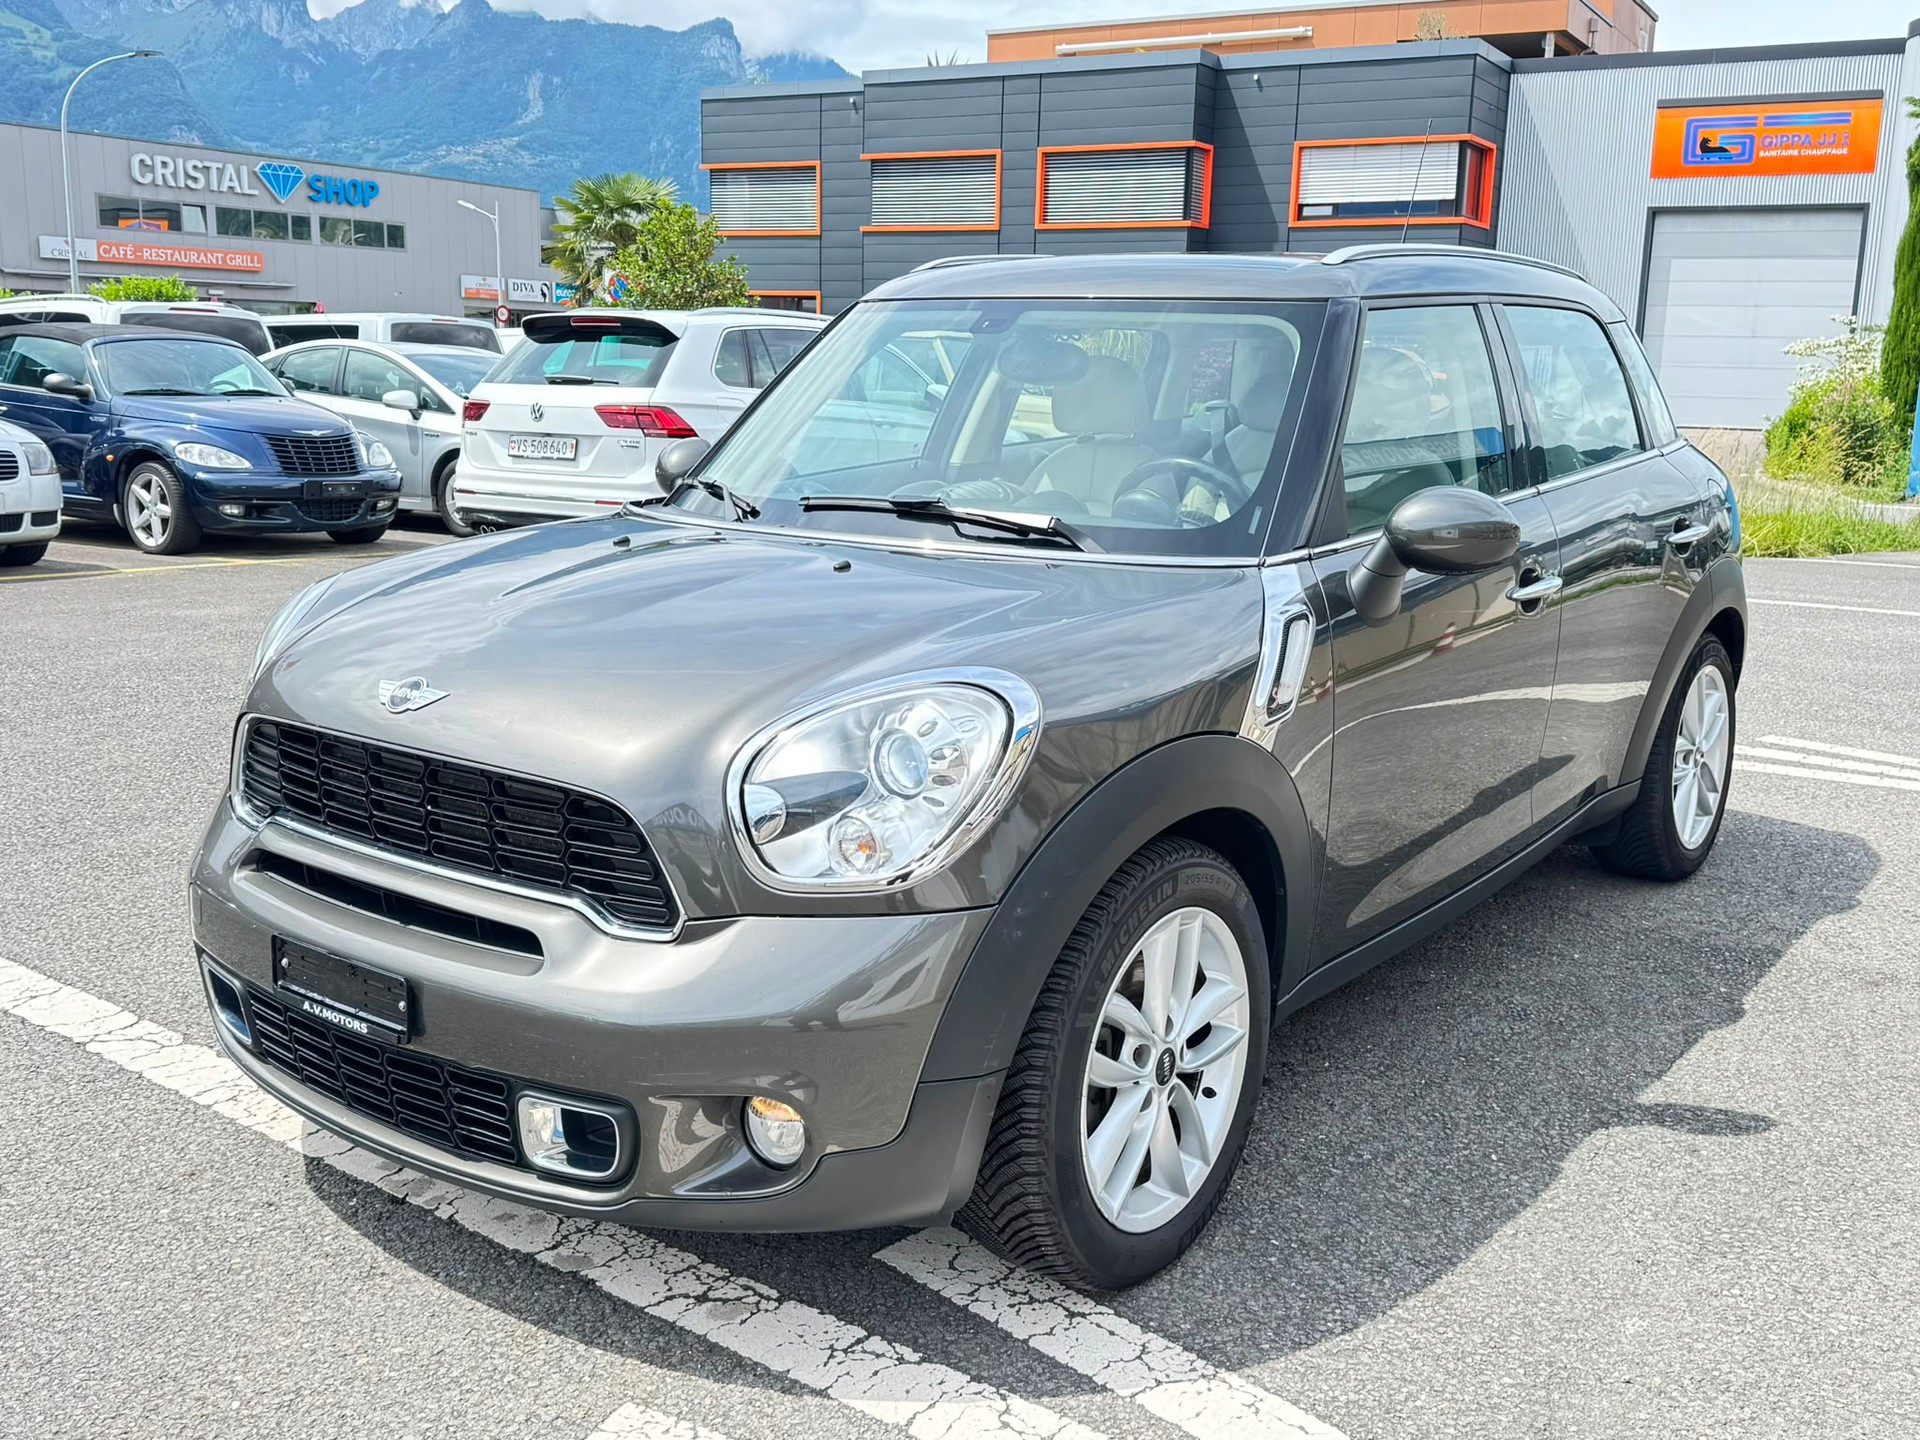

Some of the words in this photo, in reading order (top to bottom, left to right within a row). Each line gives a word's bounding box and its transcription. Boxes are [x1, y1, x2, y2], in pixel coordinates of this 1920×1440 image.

[1760, 134, 1812, 148] GIPPA
[1759, 149, 1798, 158] SANITAIRE
[1801, 147, 1848, 156] CHAUFFAGE
[130, 152, 259, 195] CRISTAL
[308, 173, 380, 207] SHOP
[51, 247, 90, 259] CRISAL
[100, 244, 134, 259] CAFÉ
[226, 252, 262, 267] GRILL
[512, 281, 535, 293] DIVA
[391, 686, 421, 700] MINI
[1185, 873, 1214, 886] 205/55
[1101, 879, 1174, 976] MICHELIN
[302, 1001, 368, 1034] A.V.MOTORS
[1162, 1053, 1171, 1082] MINI
